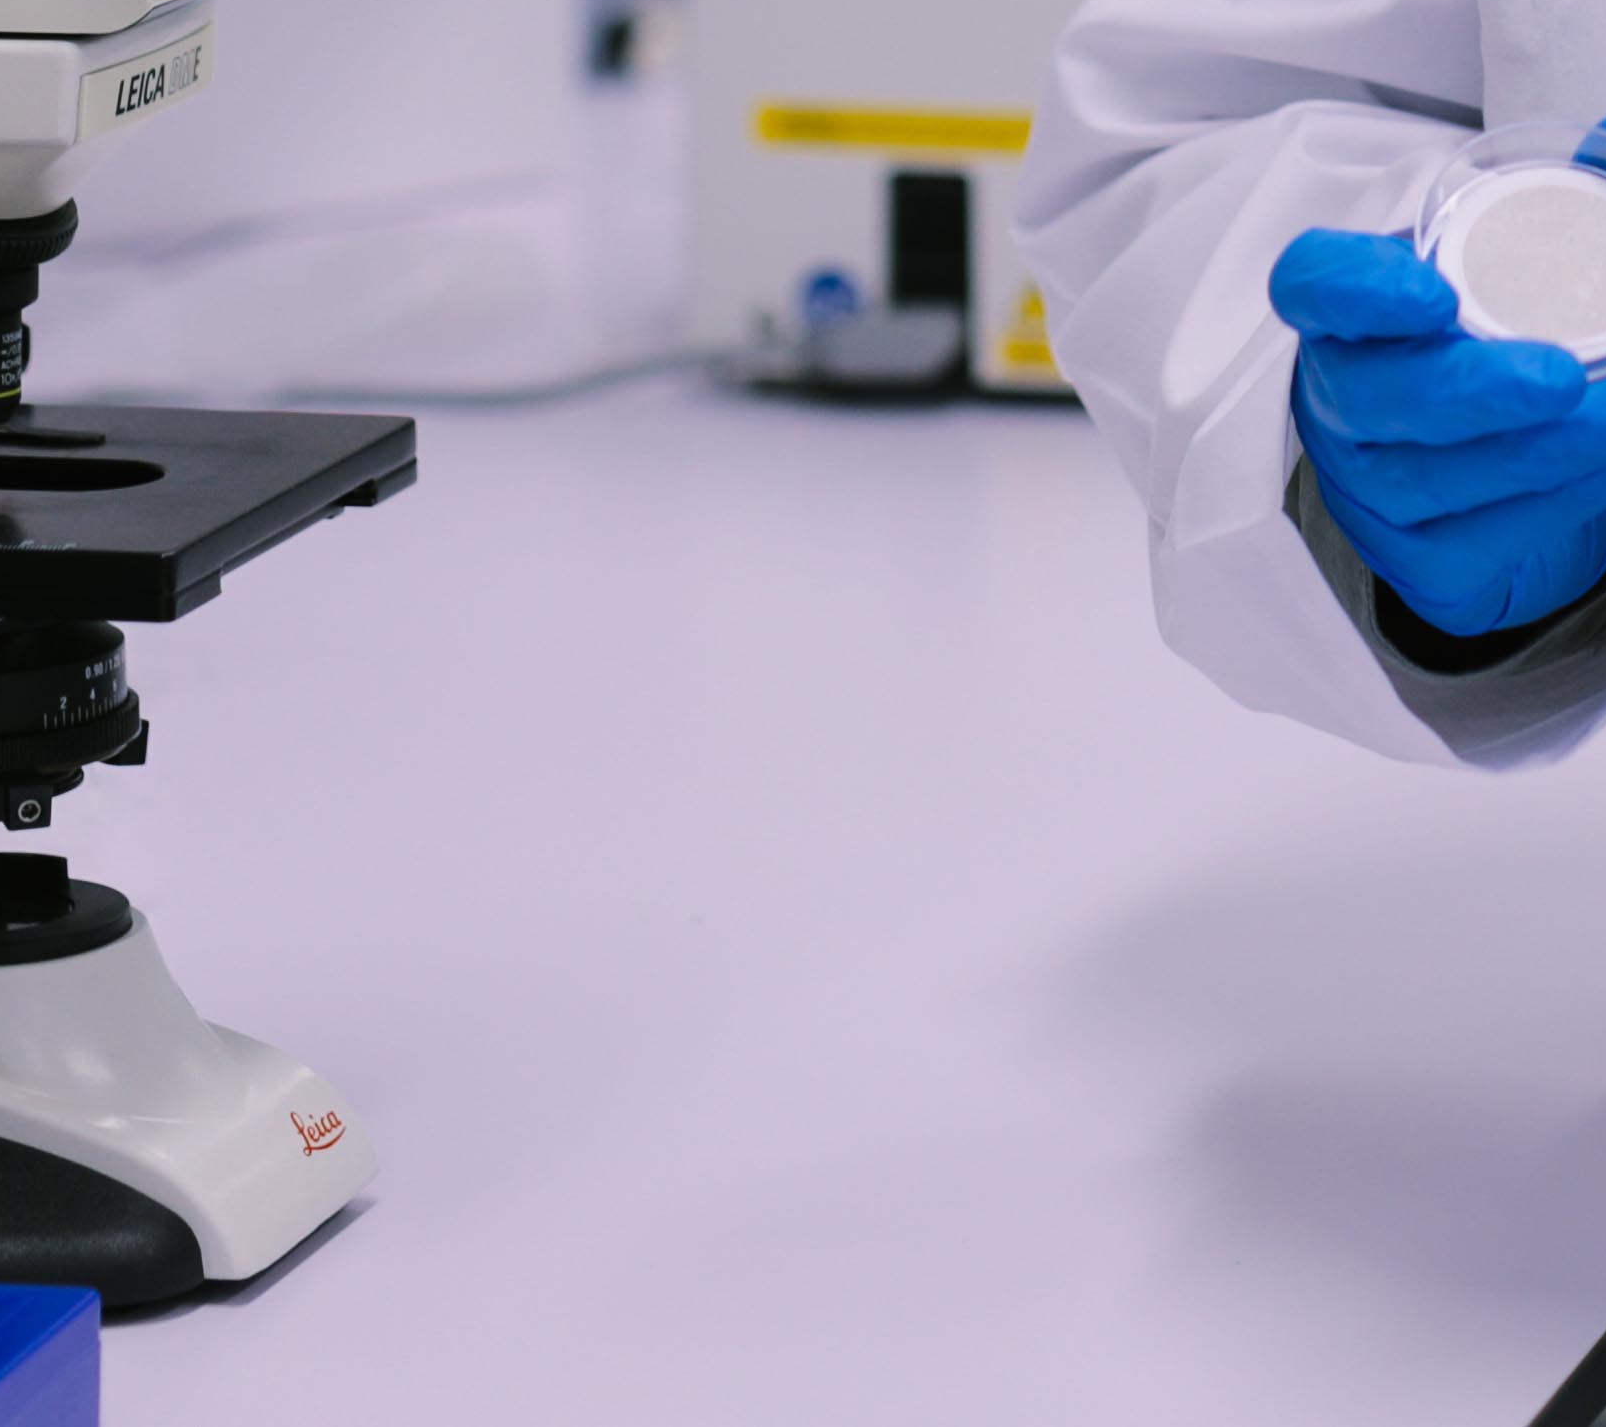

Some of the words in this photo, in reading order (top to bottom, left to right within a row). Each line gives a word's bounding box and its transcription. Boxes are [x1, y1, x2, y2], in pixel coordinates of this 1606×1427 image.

[115, 63, 166, 117] LEICA
[60, 696, 68, 710] 2
[290, 1111, 347, 1157] Leica
